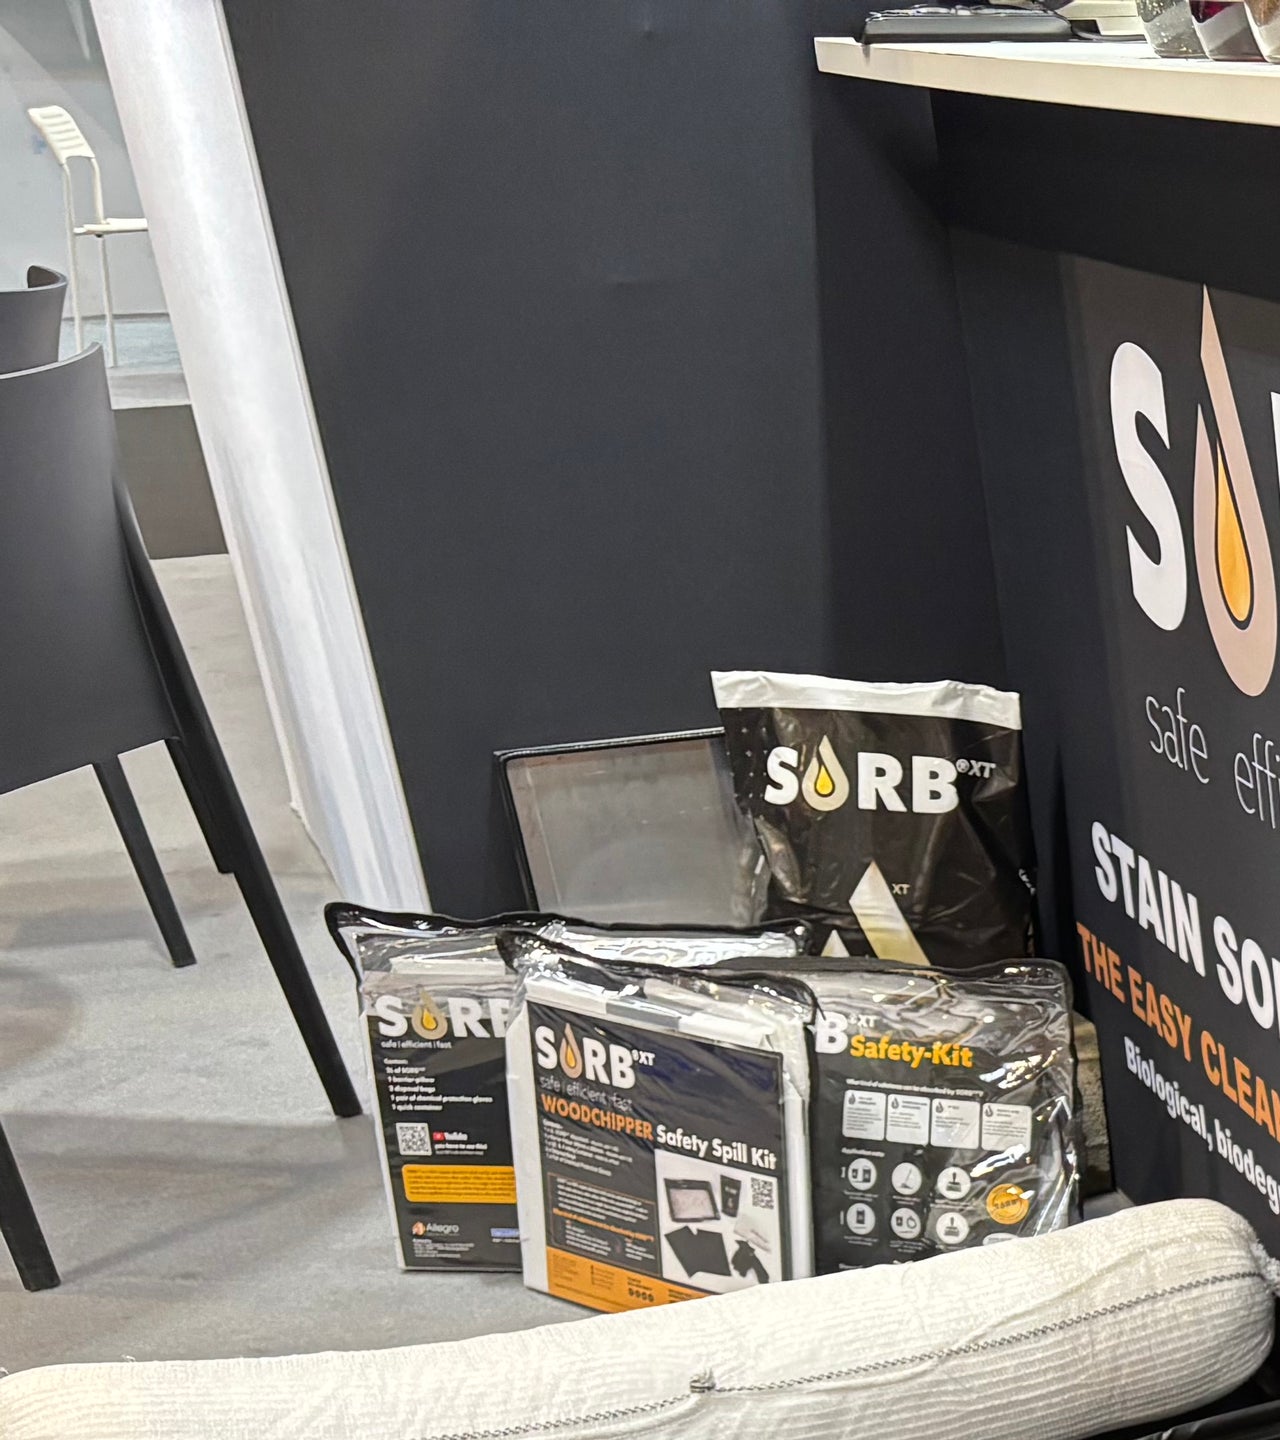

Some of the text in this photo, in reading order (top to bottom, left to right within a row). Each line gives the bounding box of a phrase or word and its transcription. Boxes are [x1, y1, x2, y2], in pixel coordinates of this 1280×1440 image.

[1145, 687, 1210, 784] safe
[892, 883, 911, 896] XT
[1091, 820, 1206, 978] STAIN
[1076, 920, 1126, 1005] THE
[1127, 965, 1193, 1063] EASY
[850, 1033, 974, 1069] Safety-Kit
[1123, 1035, 1214, 1152] Biological,
[540, 1093, 655, 1142] WOODCHIPPER
[656, 1124, 709, 1159] Safety
[712, 1138, 748, 1164] Spill
[751, 1146, 777, 1171] Kit
